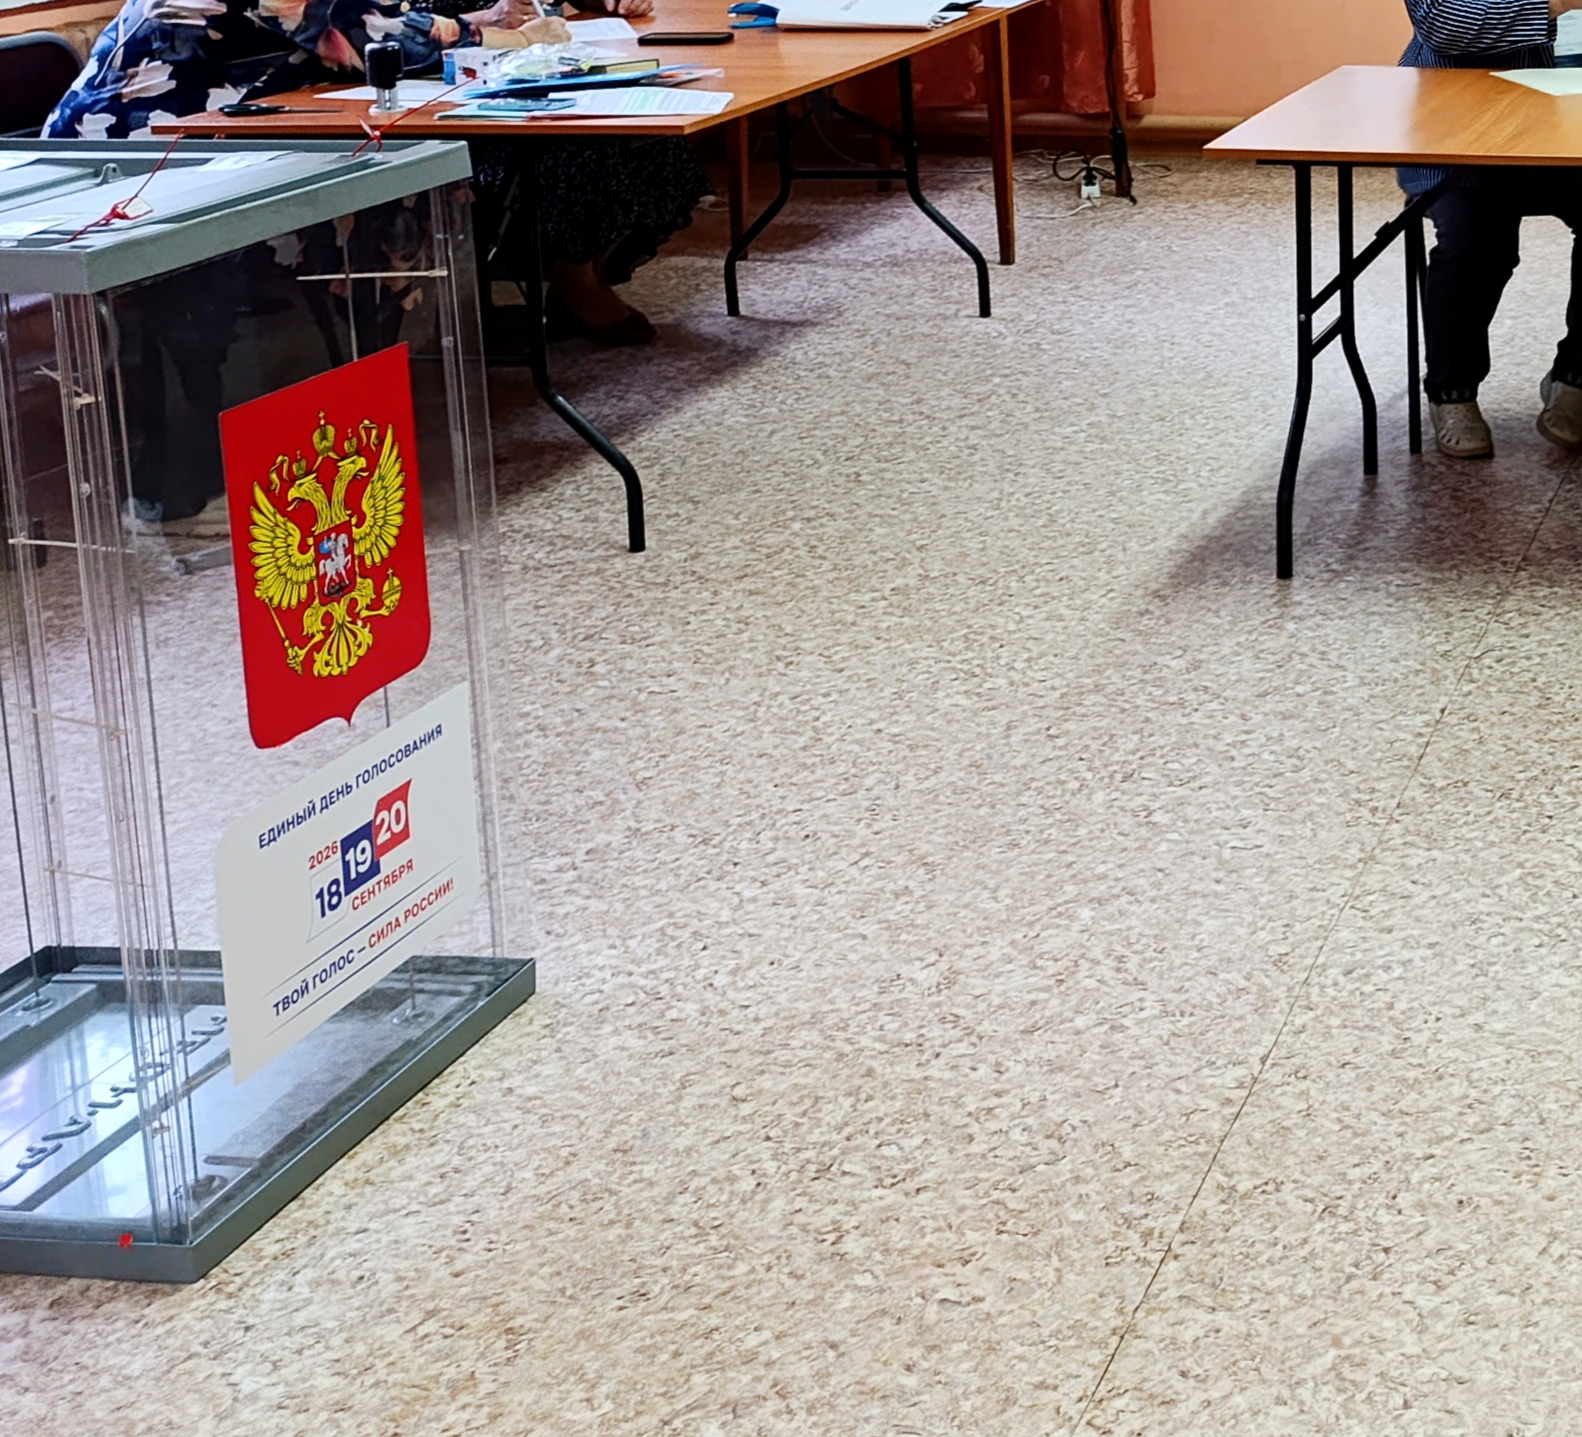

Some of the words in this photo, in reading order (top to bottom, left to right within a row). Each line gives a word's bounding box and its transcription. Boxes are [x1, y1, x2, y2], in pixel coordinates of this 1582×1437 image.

[258, 799, 316, 849] ЕДИНЫЙ
[319, 782, 353, 813] ДЕНЬ
[355, 724, 443, 789] ГОЛОСОВАНИЯ
[308, 840, 339, 870] 2026
[315, 878, 343, 919] 18
[344, 839, 372, 881] 19
[375, 800, 406, 846] 20
[352, 858, 413, 911] СЕНТЯБРЯ
[272, 979, 309, 1016] ТВОЙ
[312, 949, 355, 990] ГОЛОС
[368, 917, 401, 949] СИЛА
[403, 878, 454, 924] РОССИИ!
